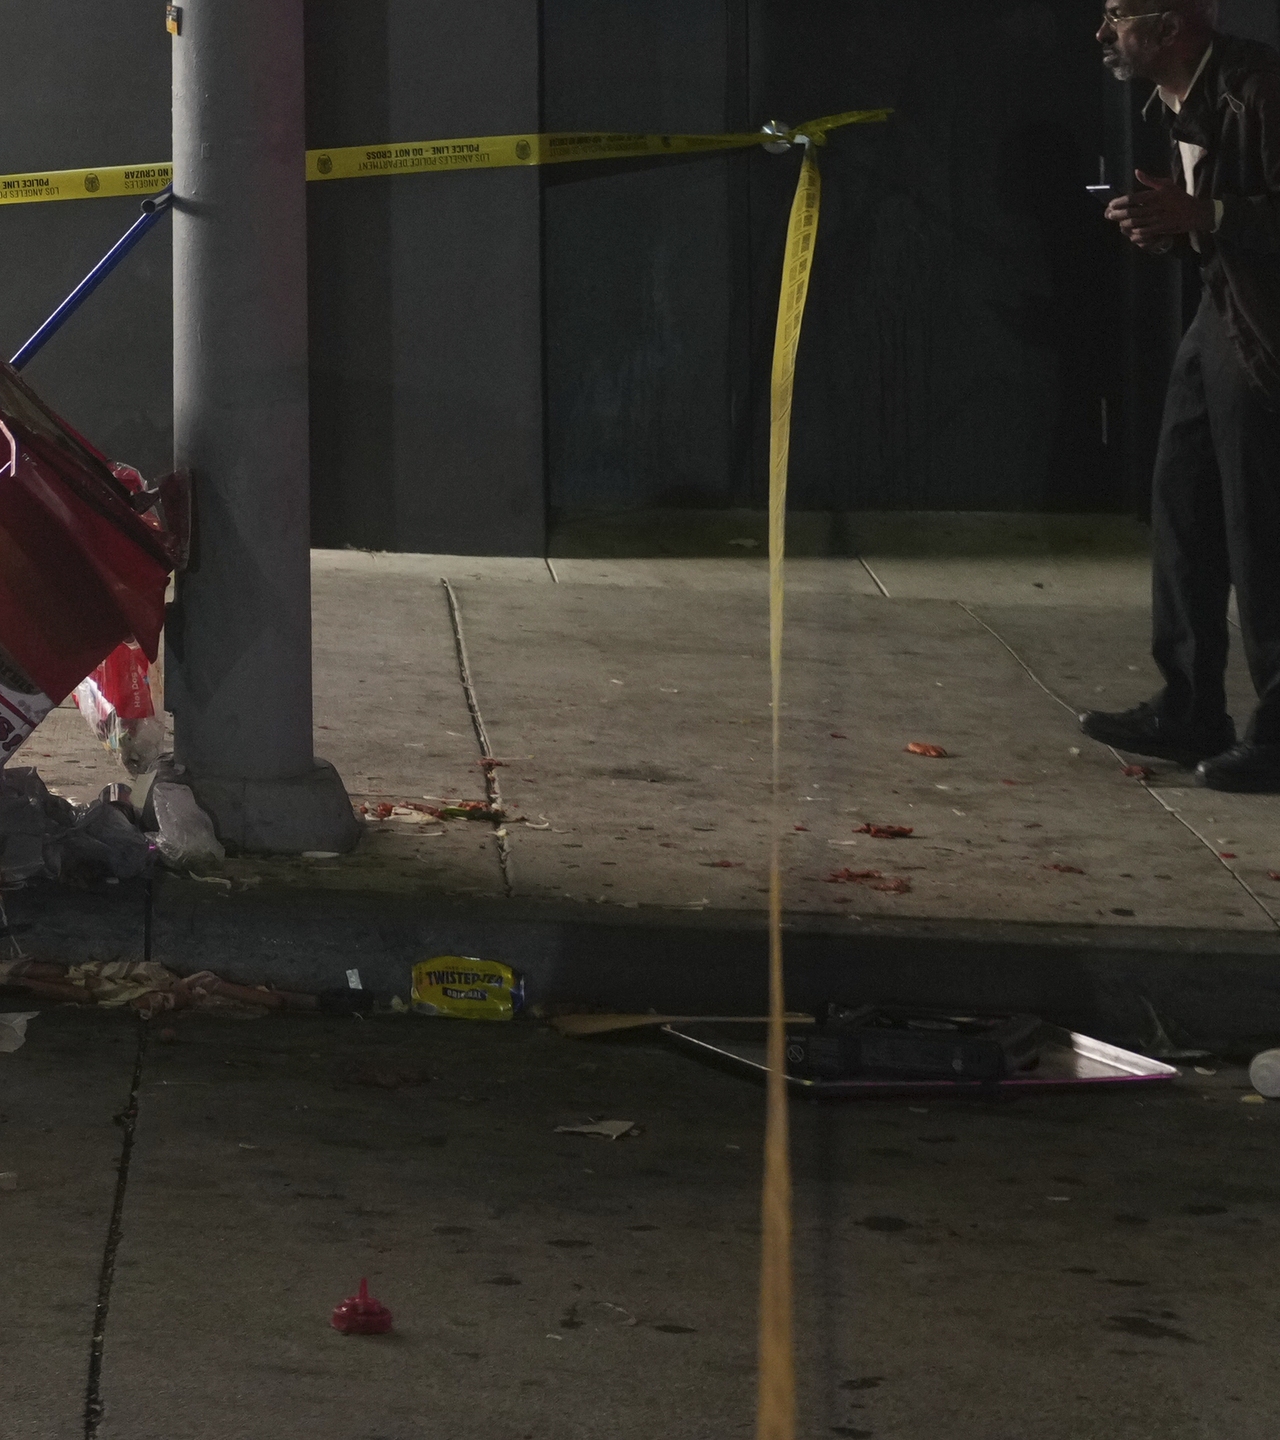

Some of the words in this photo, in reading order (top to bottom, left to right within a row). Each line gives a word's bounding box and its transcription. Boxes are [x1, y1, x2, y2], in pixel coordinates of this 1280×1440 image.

[395, 149, 410, 158] NOT
[412, 148, 423, 156] DO
[431, 146, 449, 155] LINE
[452, 144, 479, 153] POLICE
[366, 150, 392, 160] CROSS
[439, 154, 473, 165] ANGELES
[475, 153, 490, 162] LOS
[358, 158, 407, 171] DEPARTMENT
[410, 157, 437, 166] POLICE
[125, 169, 155, 179] CRUZAR
[158, 168, 169, 177] NO
[3, 180, 20, 190] LINE
[22, 178, 49, 188] POLICE
[125, 179, 159, 189] ANGELES
[10, 189, 43, 198] ANGELES
[45, 187, 59, 196] LOS
[131, 672, 139, 690] Dog
[133, 692, 141, 708] Hot
[426, 971, 481, 986] TWISTED
